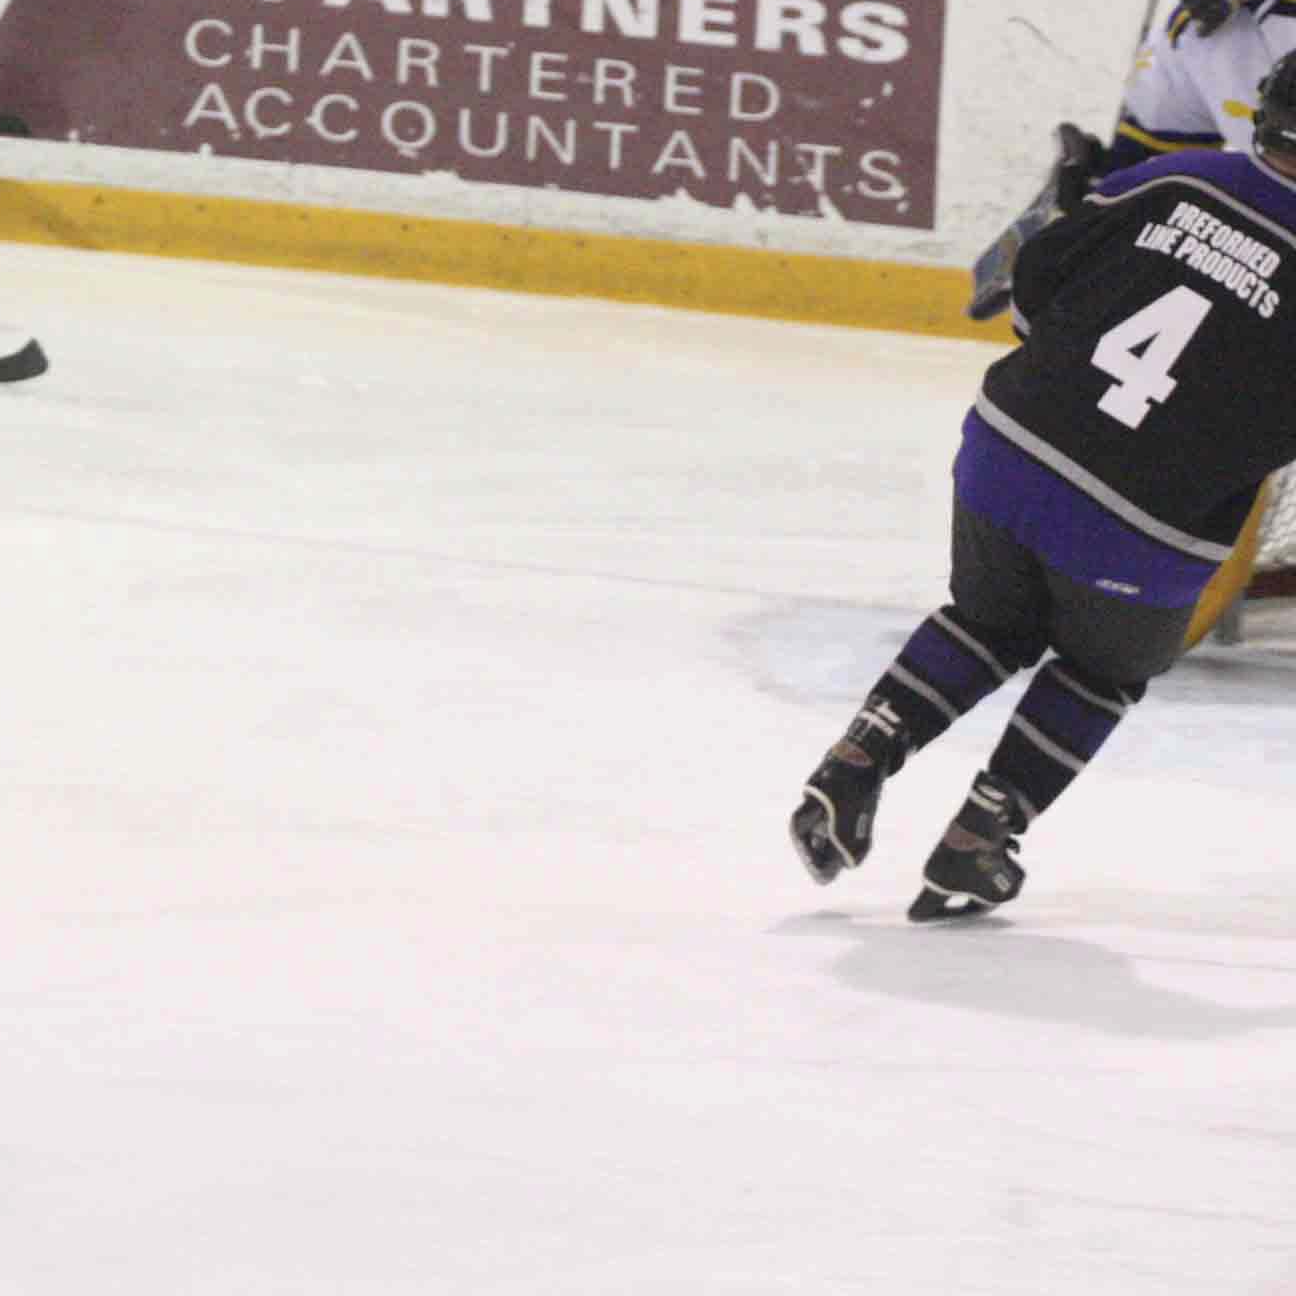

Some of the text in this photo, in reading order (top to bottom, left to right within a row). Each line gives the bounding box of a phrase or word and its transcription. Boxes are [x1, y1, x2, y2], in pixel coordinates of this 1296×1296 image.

[183, 18, 782, 122] CHARTERED
[182, 82, 908, 202] ACCOUNTANTS
[1165, 200, 1282, 280] PREFORMED
[1173, 234, 1282, 319] PRODUCTS
[1090, 284, 1214, 432] 4
